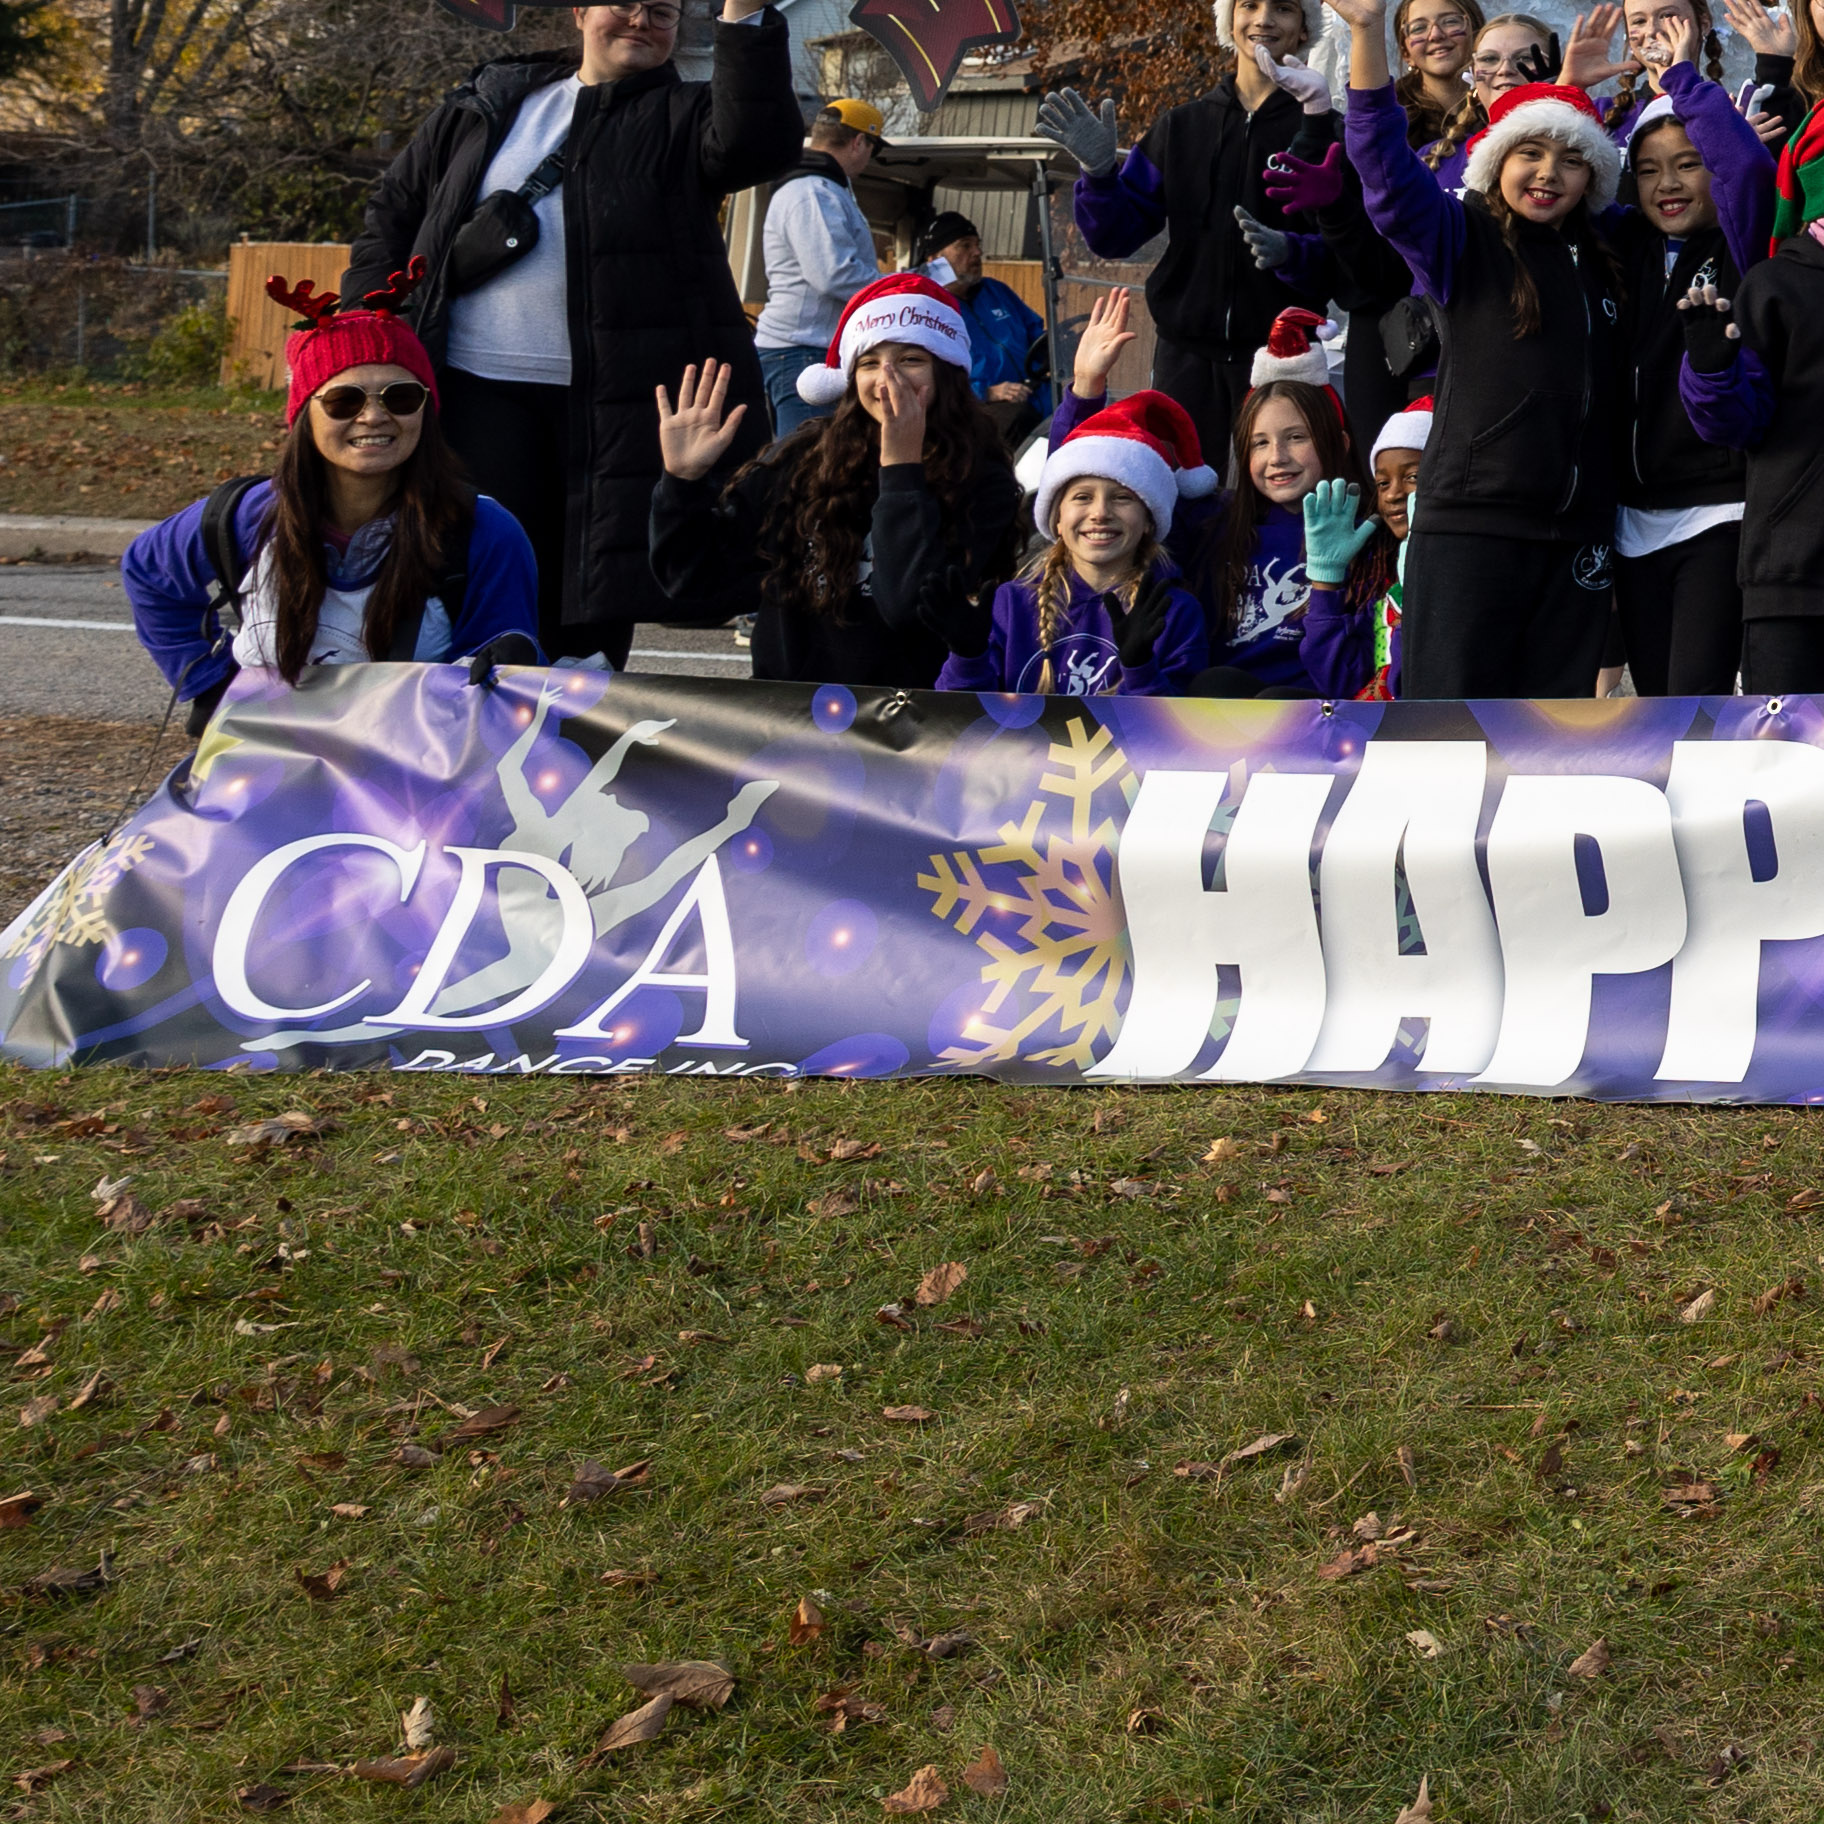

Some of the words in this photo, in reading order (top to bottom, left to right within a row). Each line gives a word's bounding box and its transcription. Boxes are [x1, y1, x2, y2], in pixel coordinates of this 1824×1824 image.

[855, 312, 897, 333] Merry
[899, 306, 959, 340] Christmas
[212, 832, 751, 1050] CDA
[392, 1048, 656, 1074] DANCE
